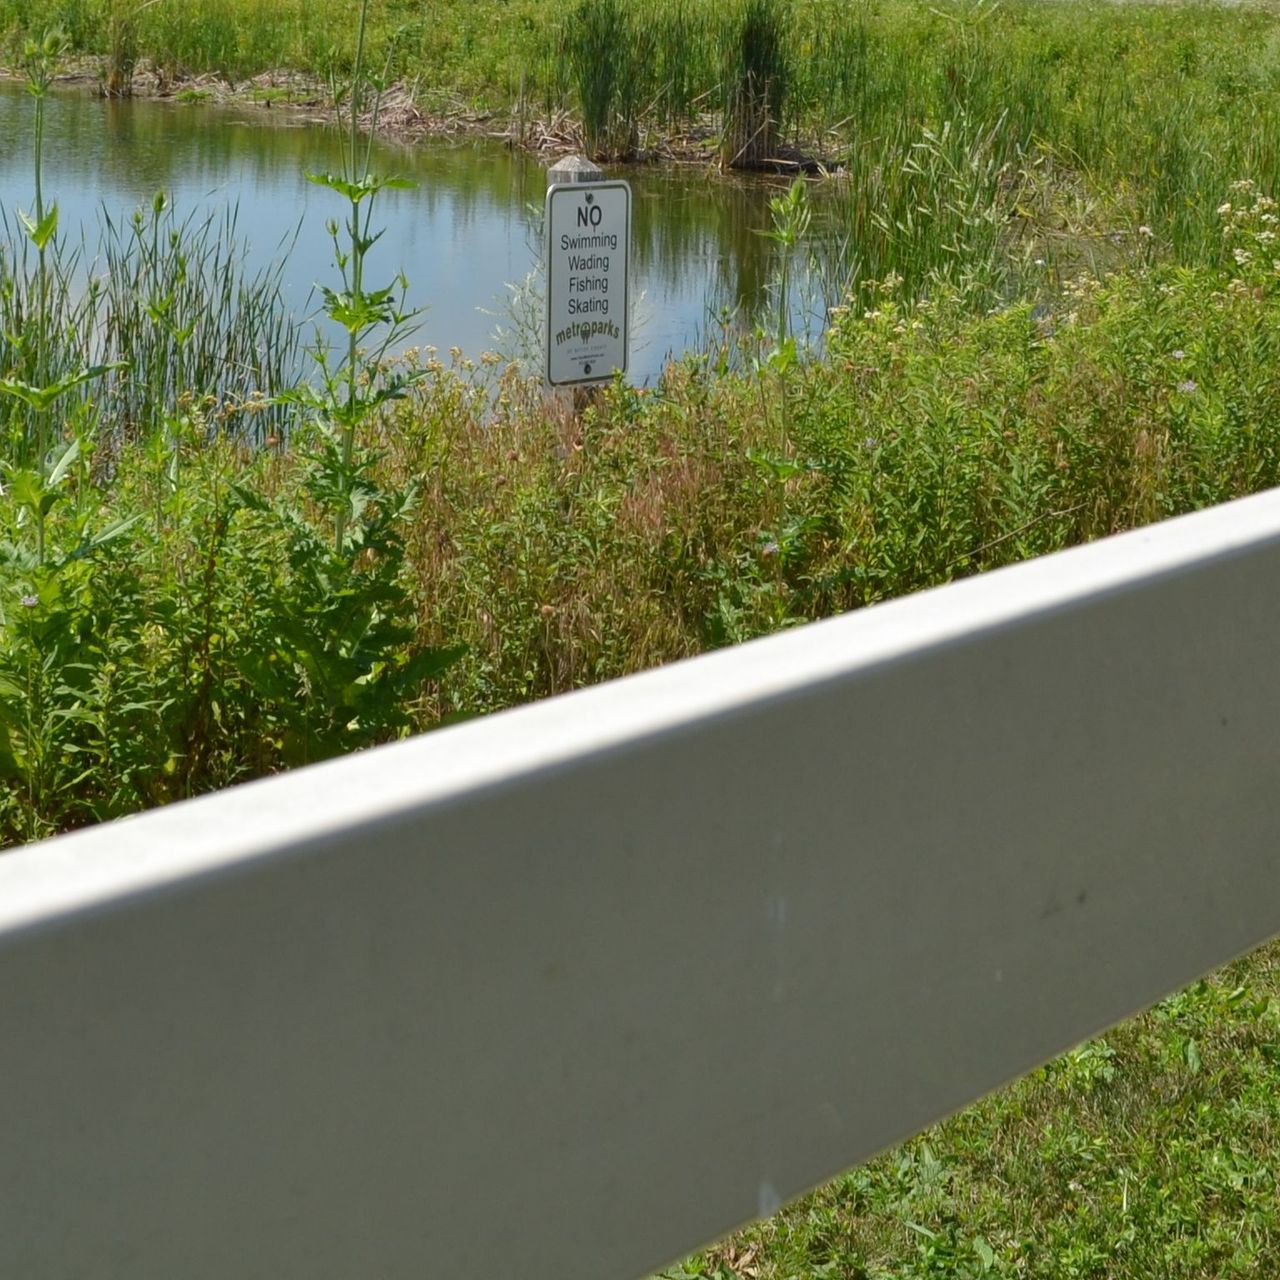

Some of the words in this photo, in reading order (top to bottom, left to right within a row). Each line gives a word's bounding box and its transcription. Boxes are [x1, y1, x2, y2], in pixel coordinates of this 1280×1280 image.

[577, 206, 602, 227] NO
[561, 232, 617, 251] Swimming
[568, 255, 609, 273] Wading
[569, 276, 608, 294] Fishing
[568, 298, 609, 315] Skating
[556, 319, 620, 346] metroparks
